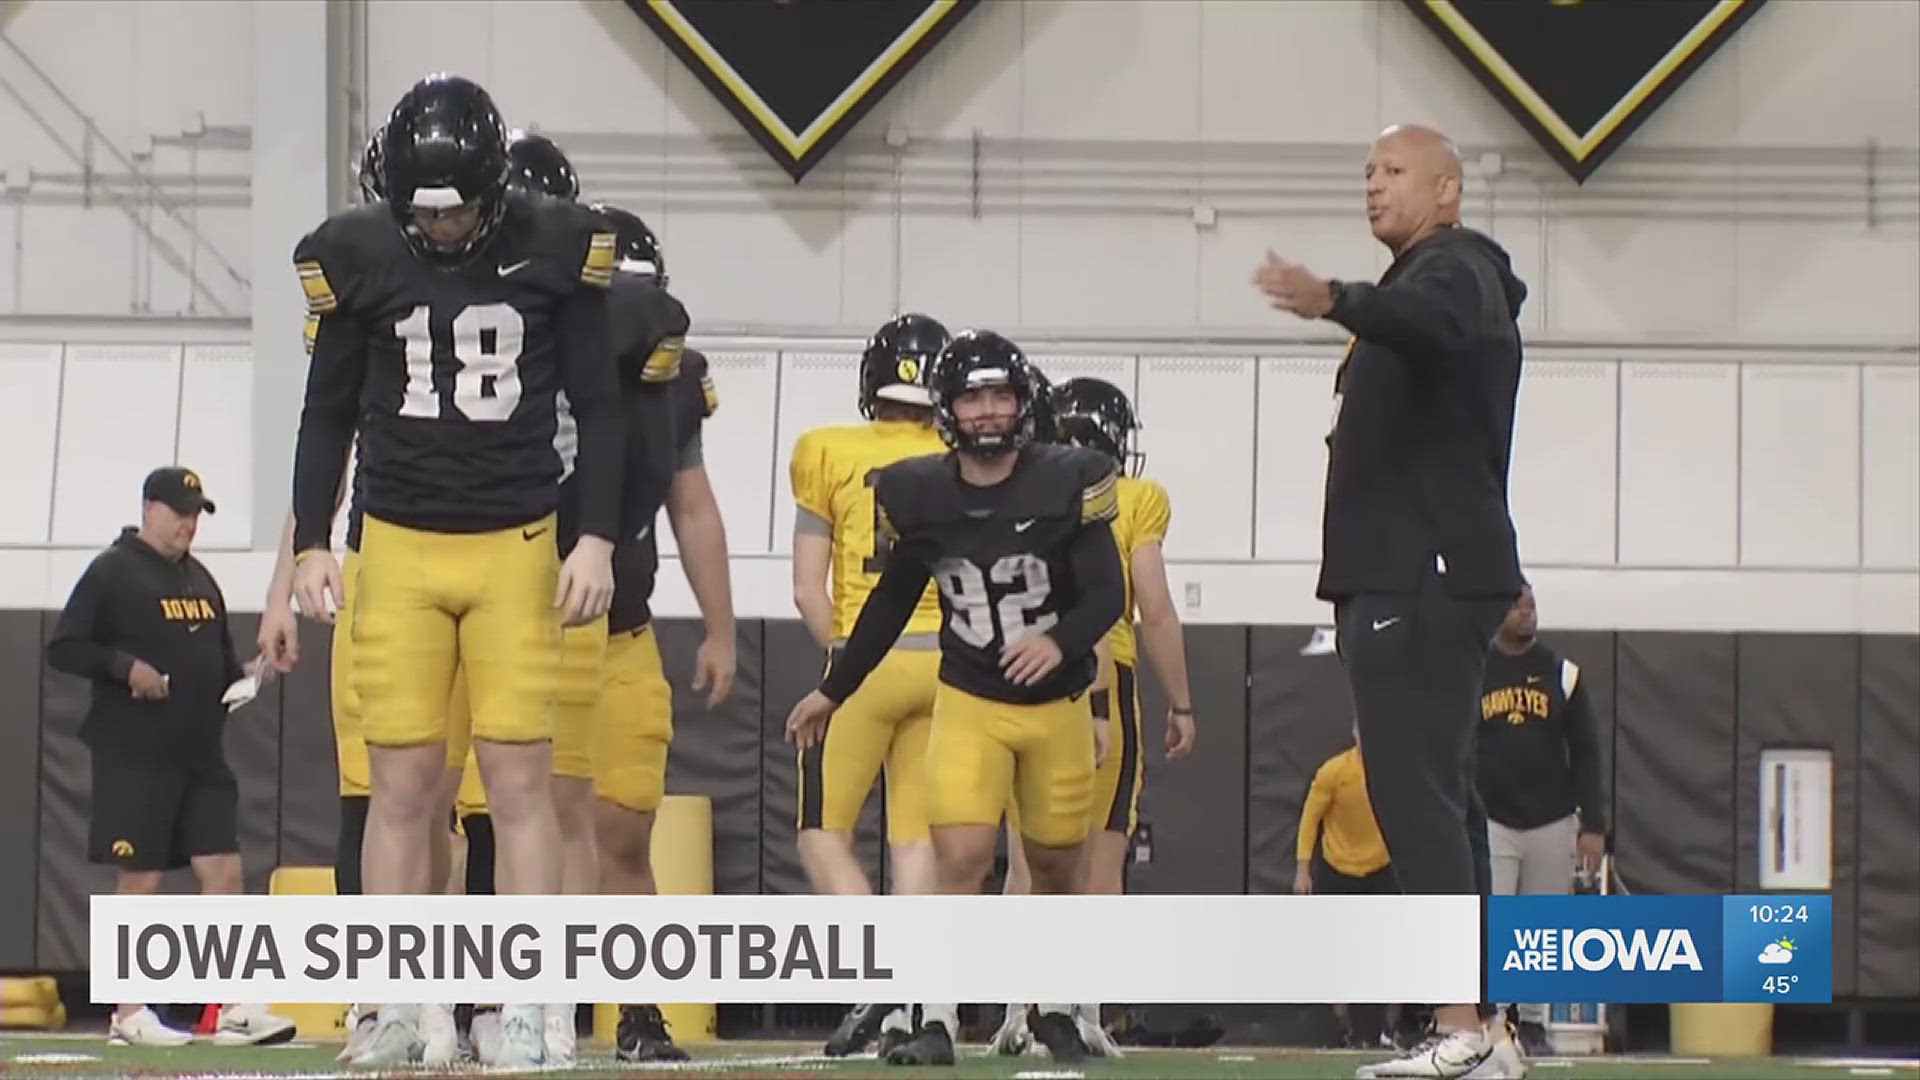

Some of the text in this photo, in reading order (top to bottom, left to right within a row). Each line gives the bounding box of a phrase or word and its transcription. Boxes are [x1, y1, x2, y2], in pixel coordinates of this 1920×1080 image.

[394, 303, 524, 421] 18
[160, 598, 216, 620] IOWA
[933, 553, 1059, 649] 92
